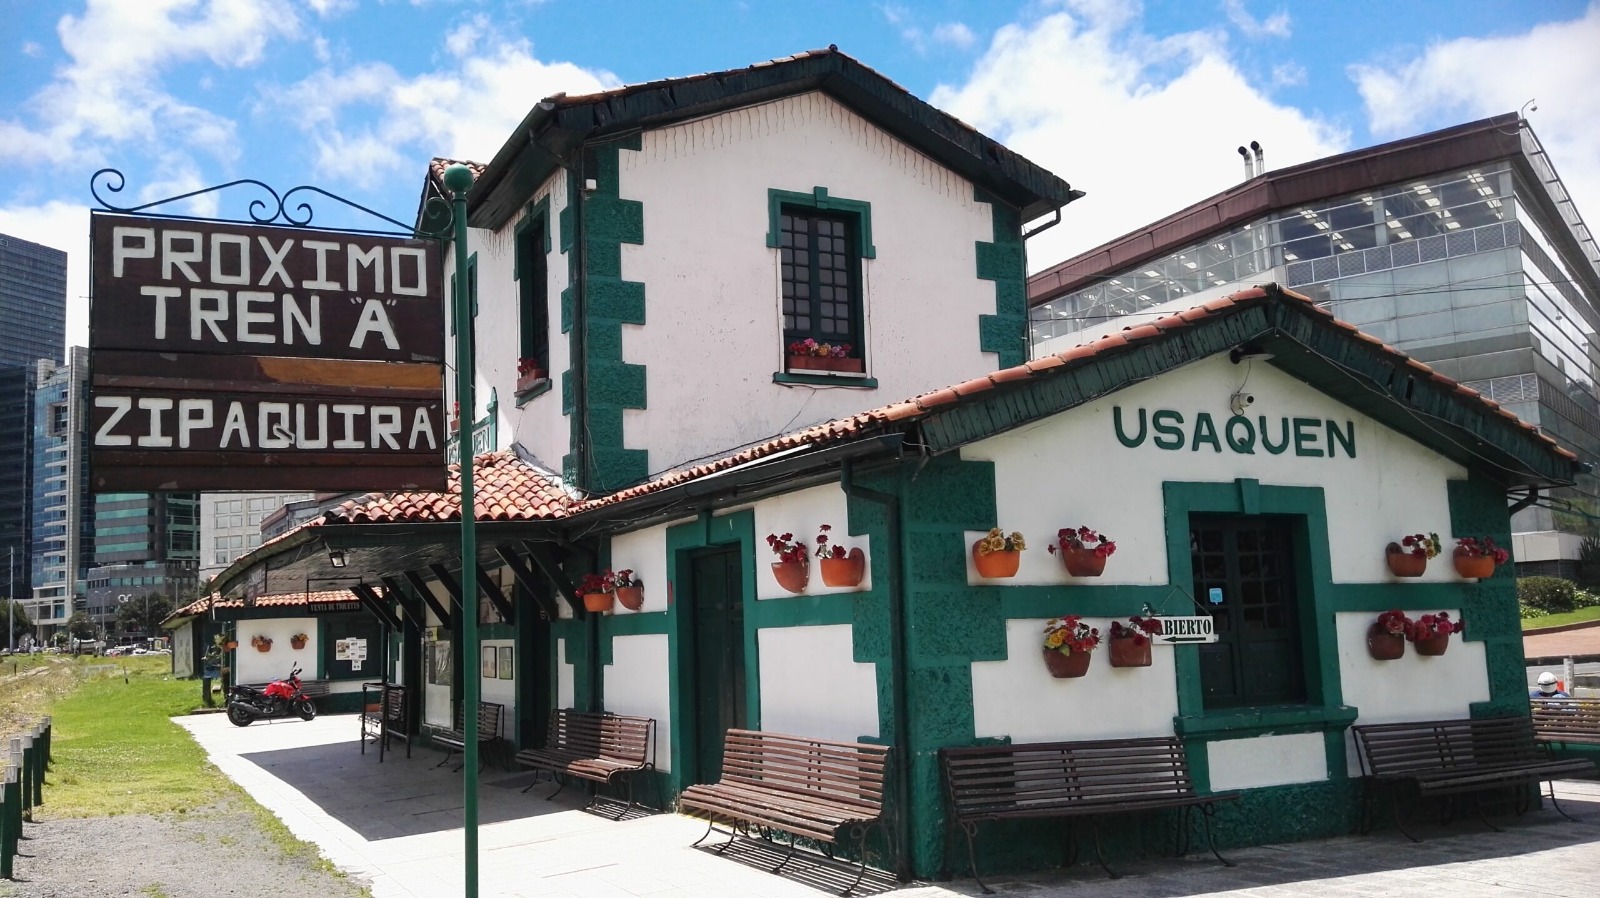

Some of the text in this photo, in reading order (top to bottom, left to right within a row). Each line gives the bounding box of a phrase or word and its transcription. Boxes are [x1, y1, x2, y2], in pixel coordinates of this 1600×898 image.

[113, 226, 427, 296] PROXIMO
[140, 286, 321, 345] TREN
[1113, 406, 1357, 459] USAQUEN
[1161, 619, 1212, 635] BIERTO
